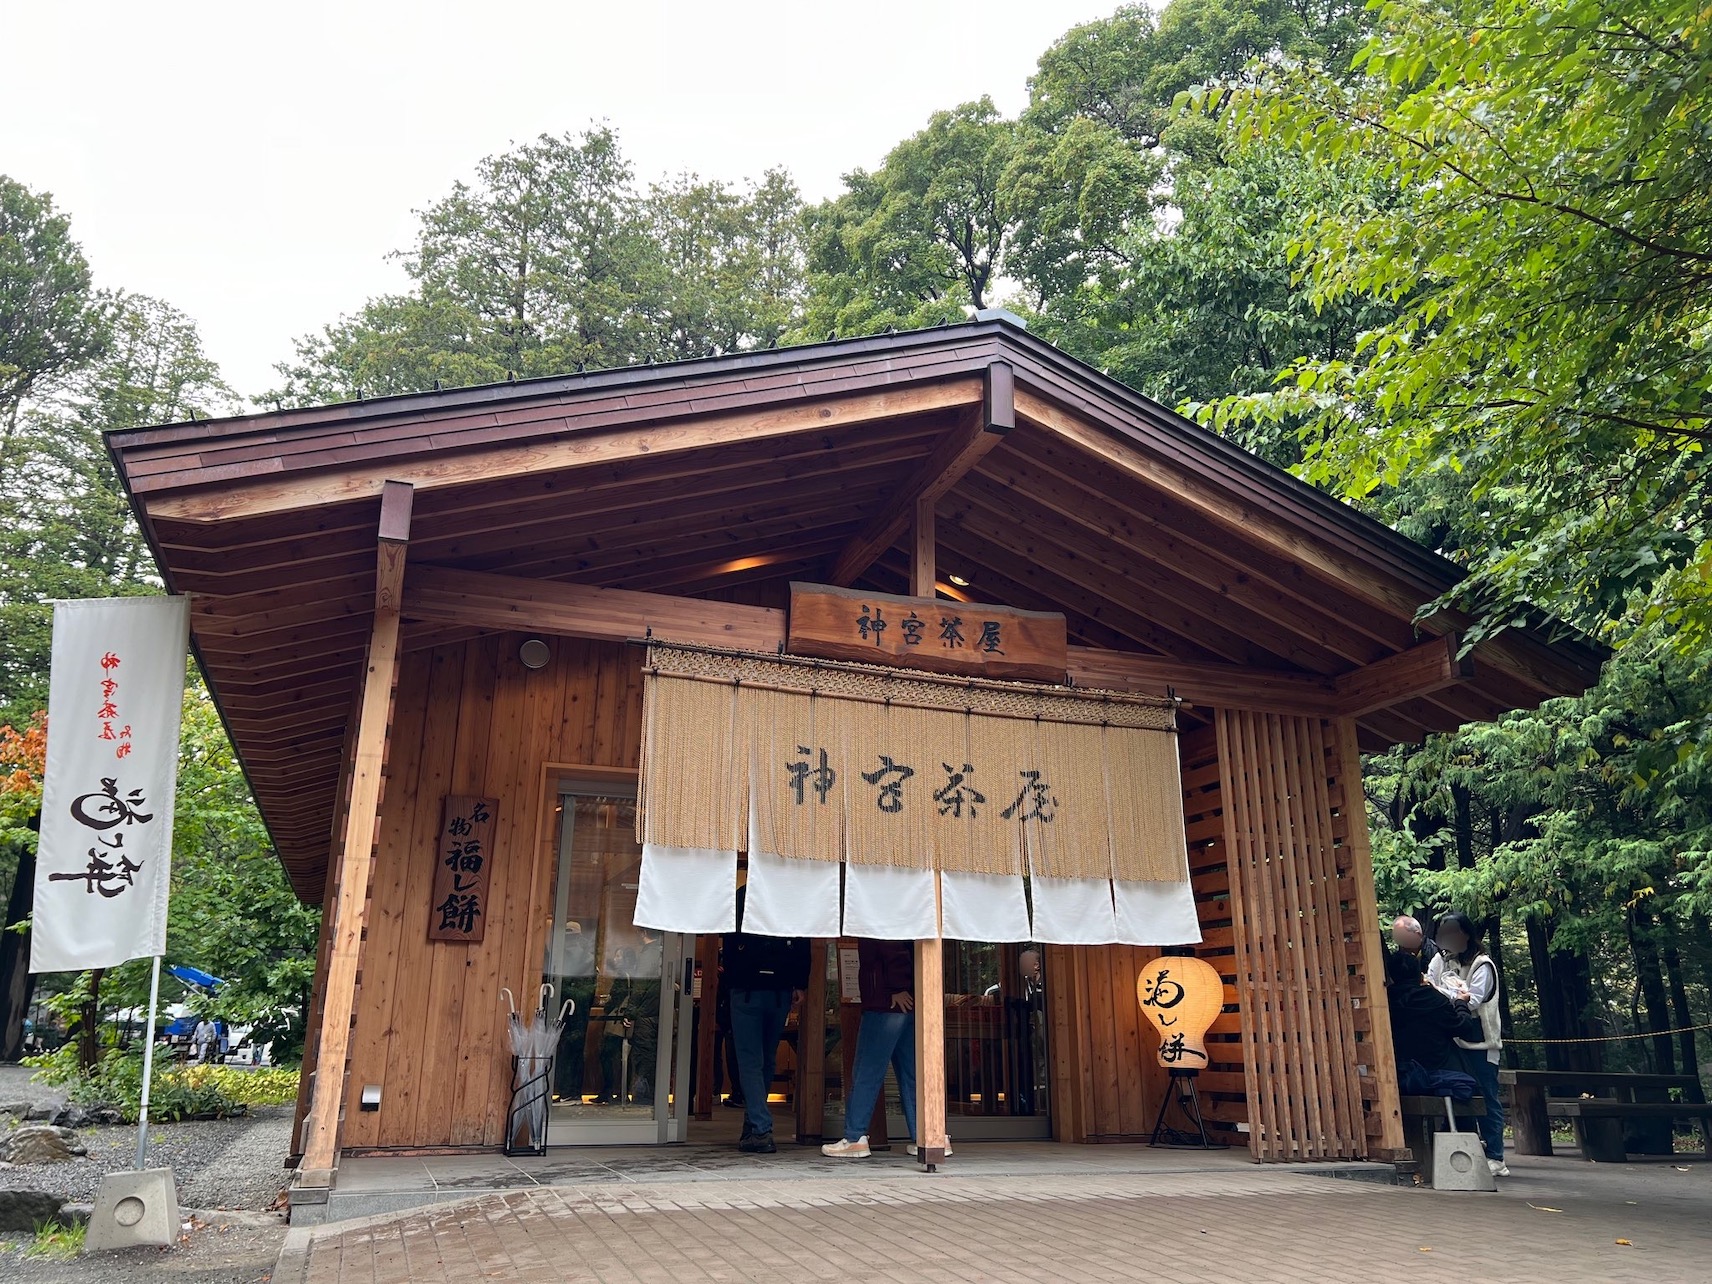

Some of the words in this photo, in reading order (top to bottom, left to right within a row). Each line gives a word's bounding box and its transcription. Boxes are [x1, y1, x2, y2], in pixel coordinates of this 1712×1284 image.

[855, 604, 1005, 655] 神宮茶屋
[785, 745, 1059, 822] 神宮茶屋
[437, 839, 484, 934] 福し餅
